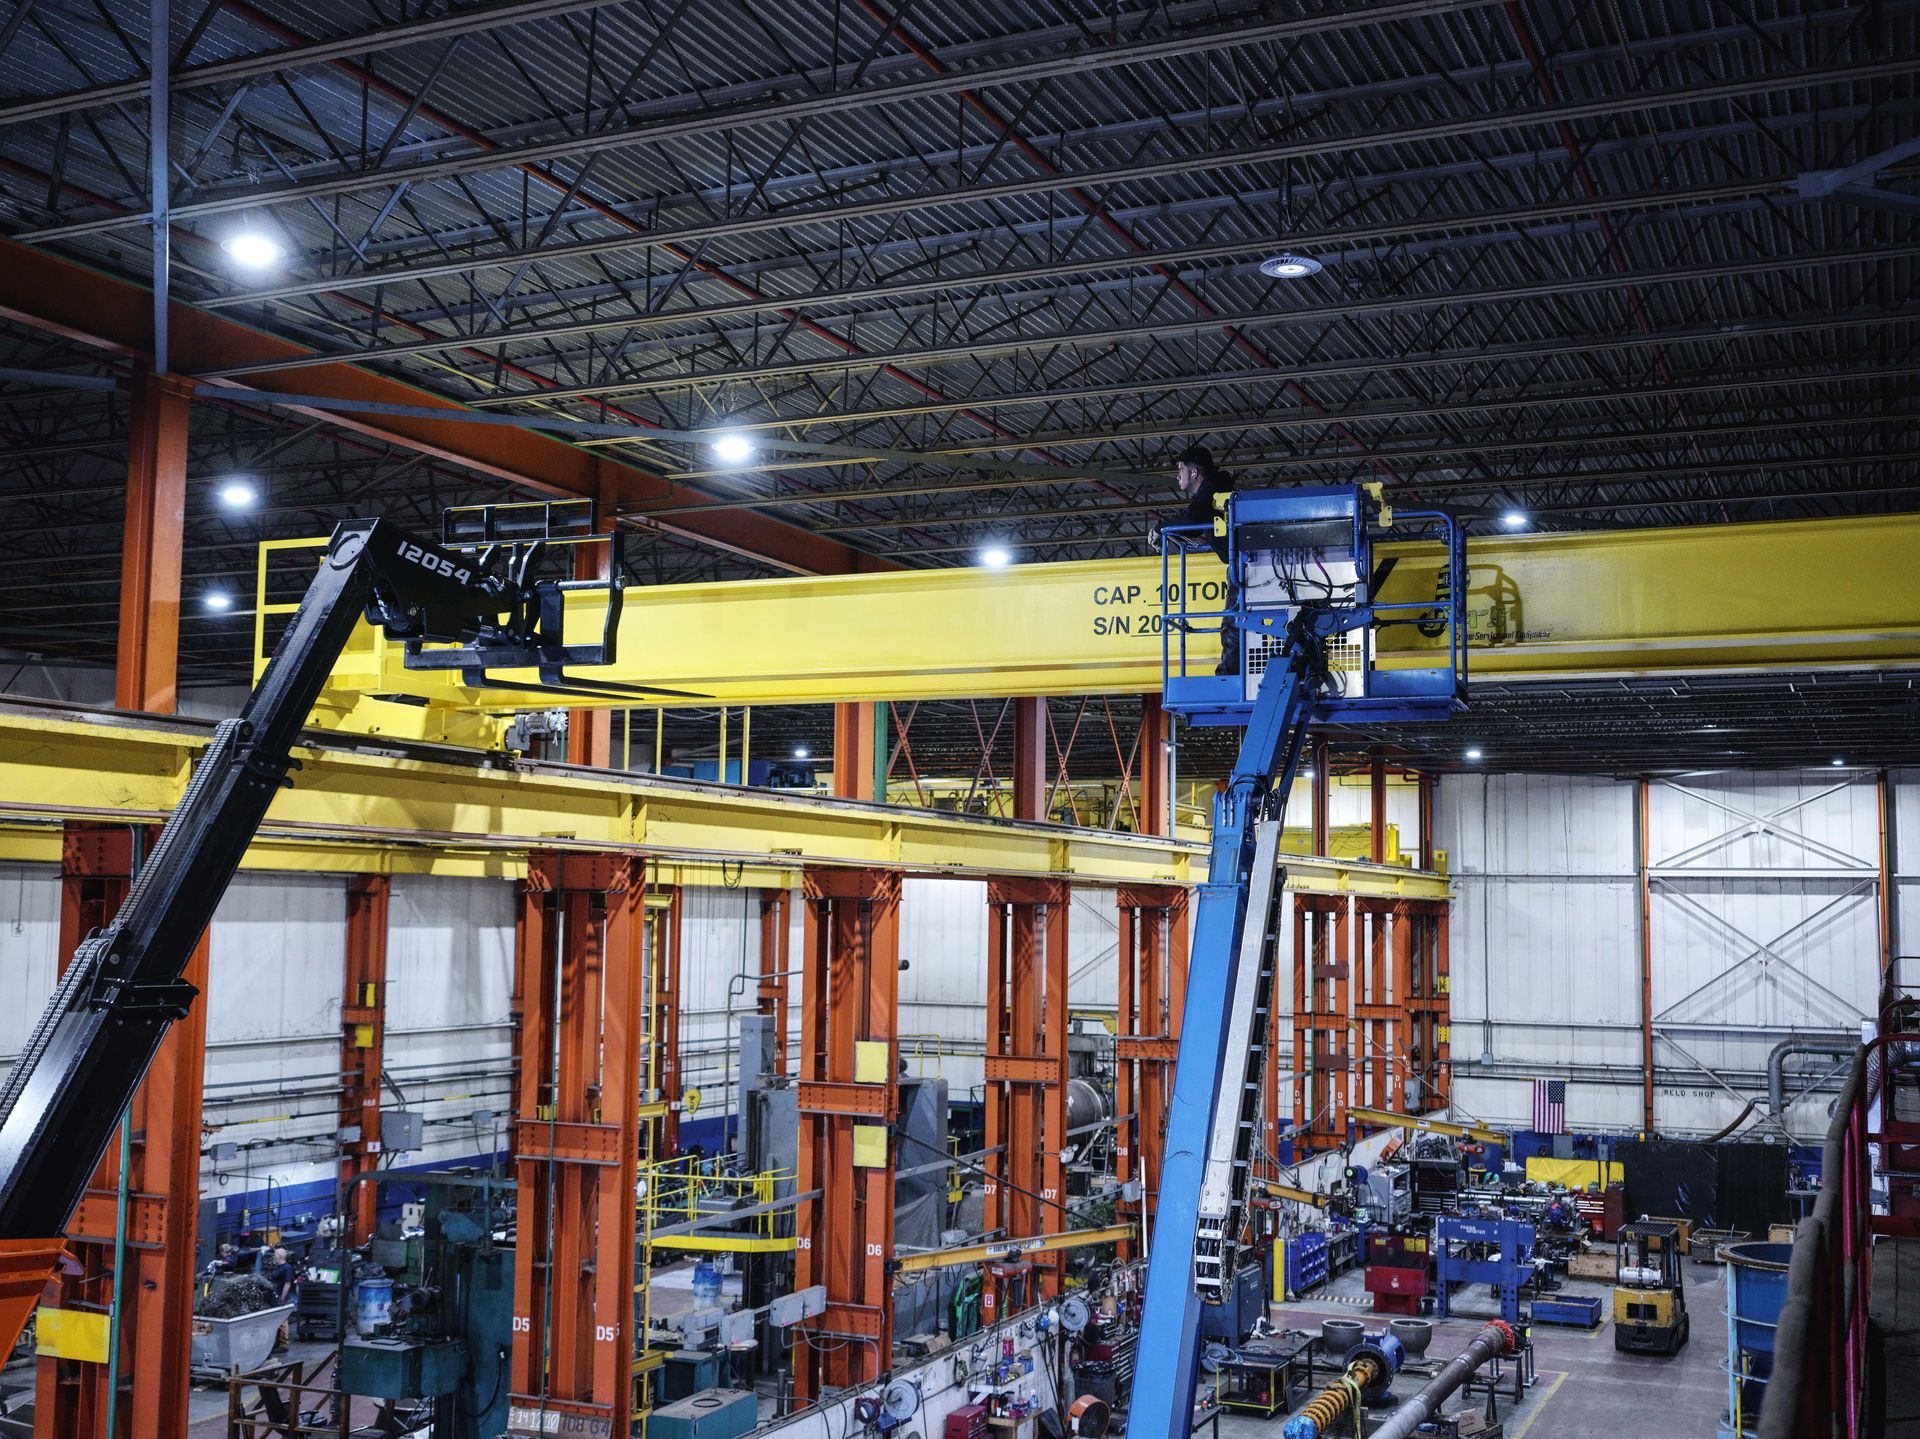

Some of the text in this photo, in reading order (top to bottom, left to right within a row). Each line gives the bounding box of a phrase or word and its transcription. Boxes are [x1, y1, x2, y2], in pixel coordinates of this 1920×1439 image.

[397, 541, 471, 585] 12054
[1094, 585, 1147, 606] CAP.
[1156, 583, 1181, 603] 10
[1094, 616, 1130, 635] S/N
[1692, 1089, 1716, 1098] SHOP
[1117, 1146, 1128, 1156] D8
[984, 1184, 997, 1195] D7
[1044, 1188, 1058, 1200] D7
[797, 1237, 812, 1249] D6
[867, 1243, 882, 1257] D6
[512, 1316, 530, 1332] D5
[596, 1325, 614, 1342] D5
